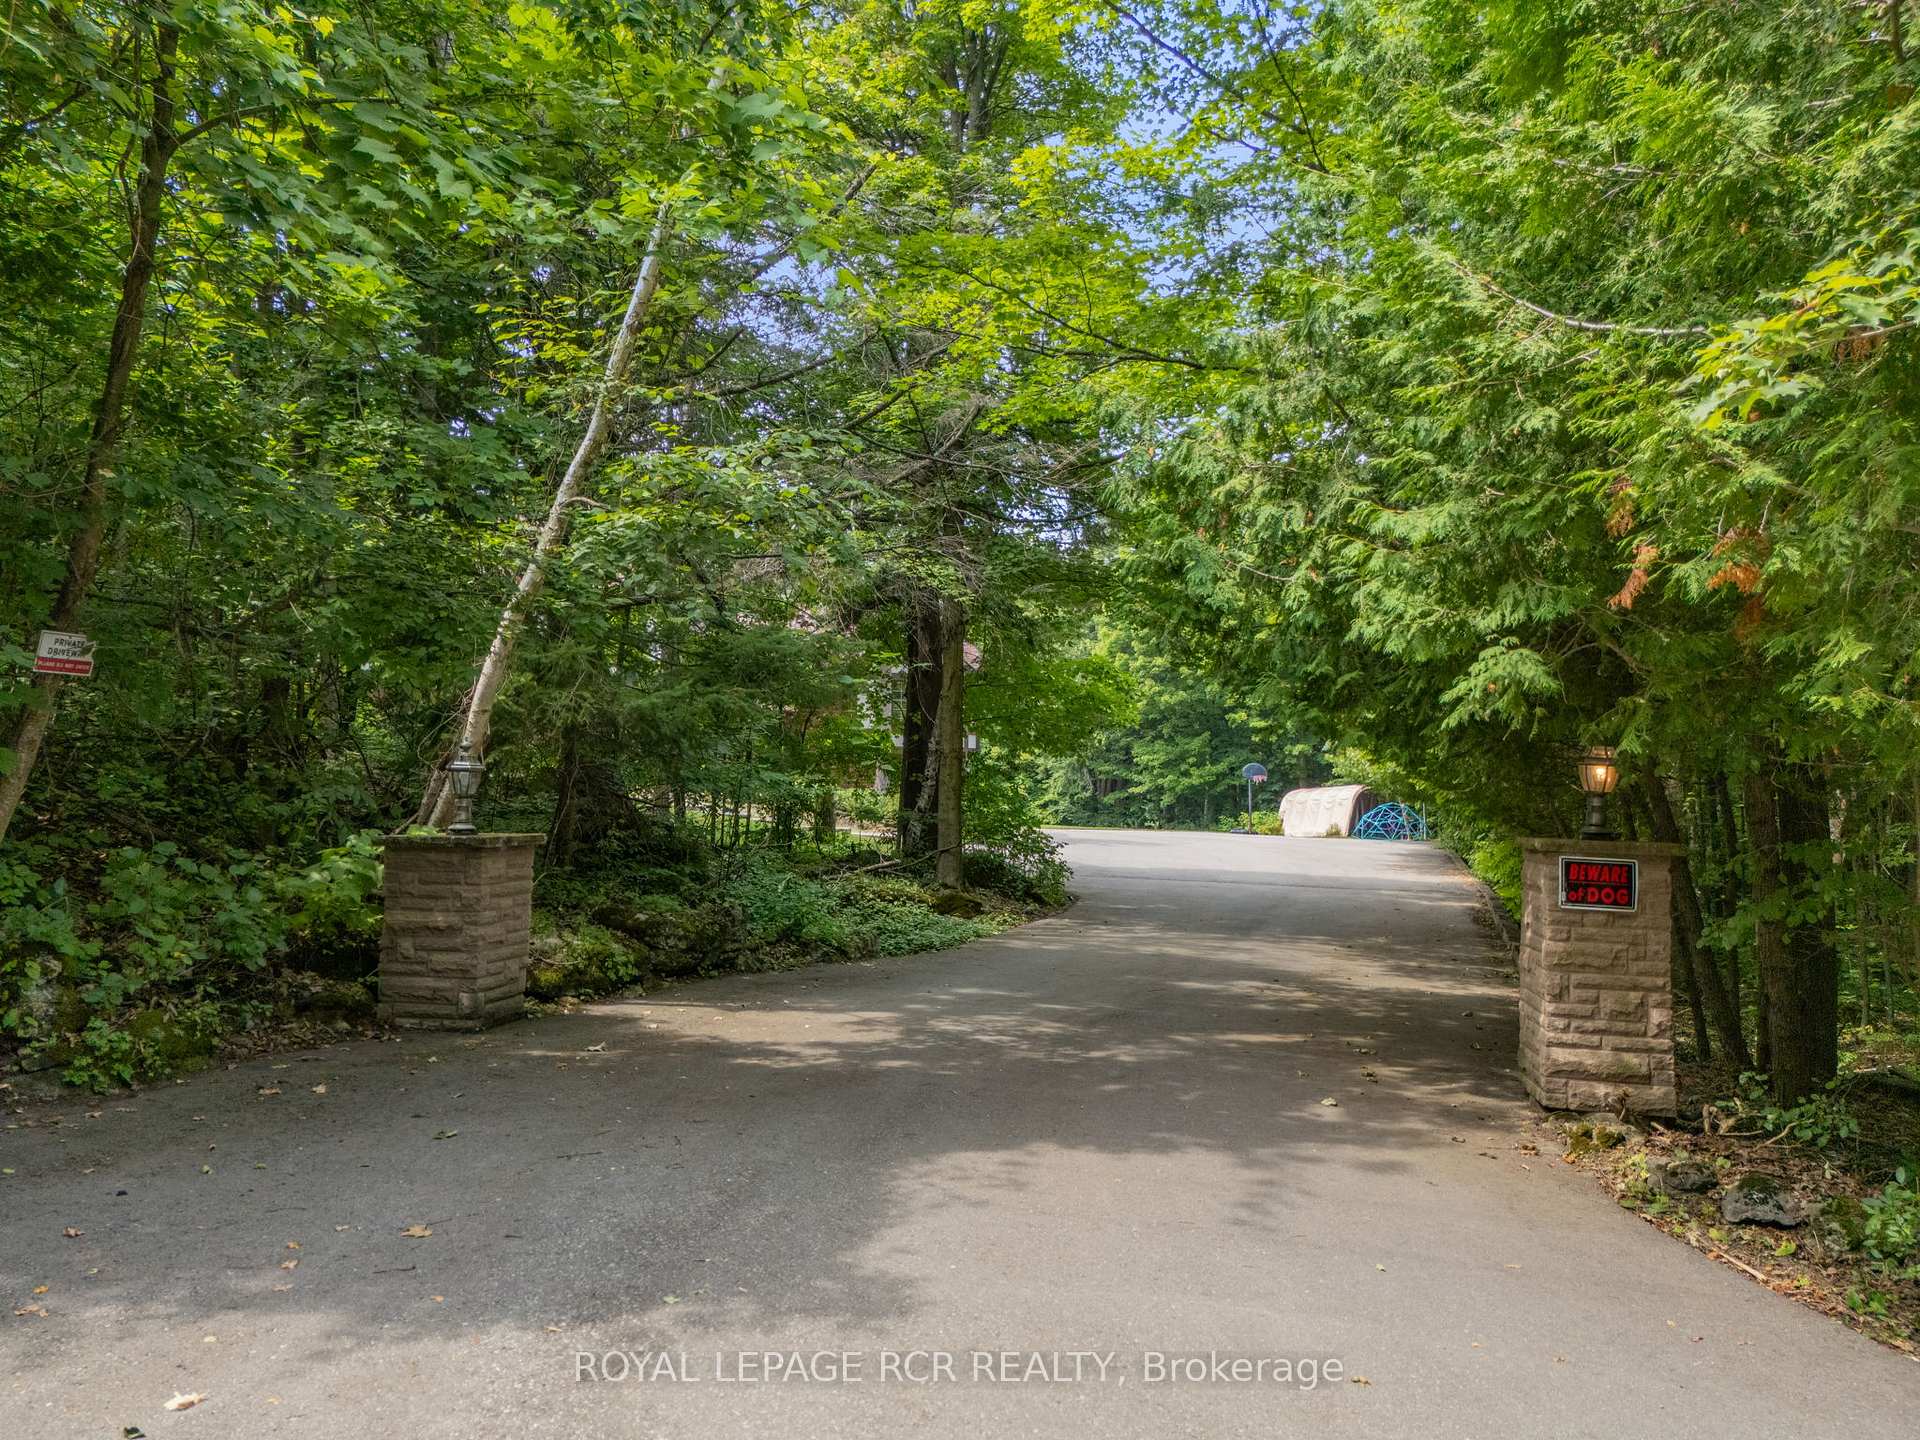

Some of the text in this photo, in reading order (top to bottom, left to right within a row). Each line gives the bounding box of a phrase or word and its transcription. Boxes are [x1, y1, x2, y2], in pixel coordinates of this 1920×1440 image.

[47, 647, 82, 658] DRIVEW
[1568, 863, 1628, 883] BEWARE
[1567, 886, 1629, 905] of DOG
